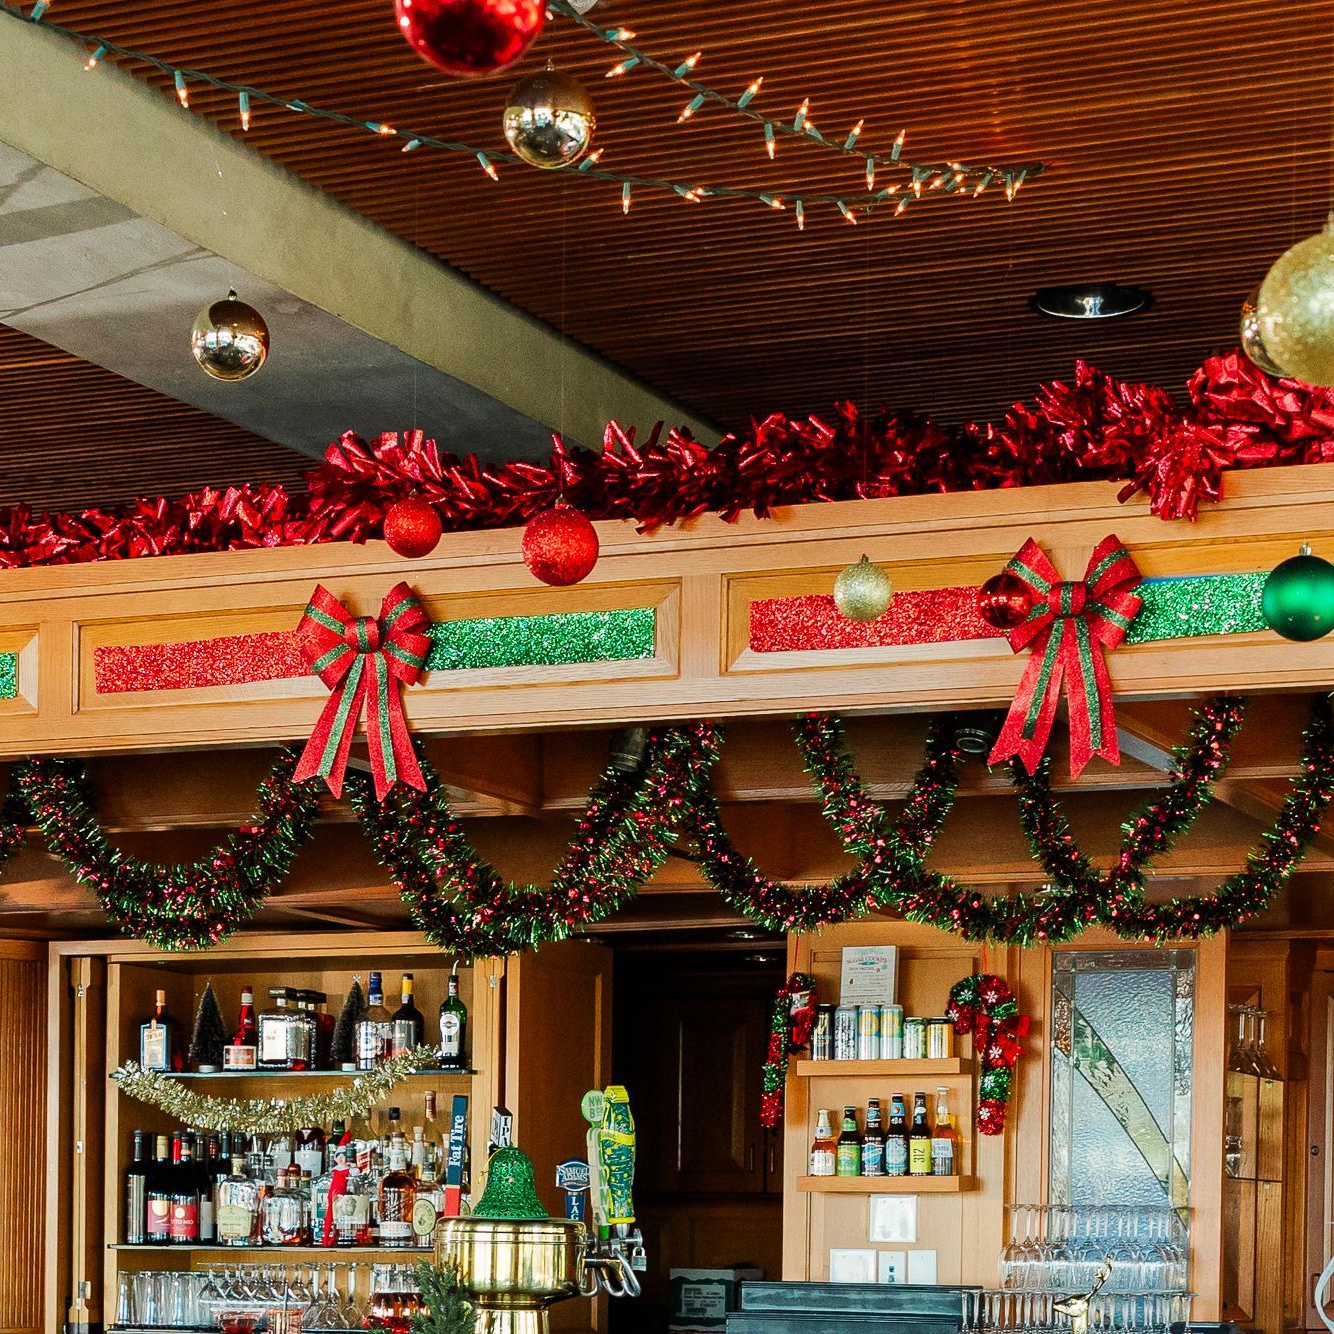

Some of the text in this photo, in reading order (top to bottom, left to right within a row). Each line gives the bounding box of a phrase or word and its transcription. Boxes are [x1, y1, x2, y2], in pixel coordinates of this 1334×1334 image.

[588, 1095, 603, 1107] NW
[501, 1117, 510, 1147] IPA
[448, 1114, 465, 1168] Fat Tire
[913, 1148, 926, 1163] 312
[558, 1166, 590, 1176] SAMUEL
[561, 1174, 589, 1182] ADAMS
[570, 1196, 579, 1221] LAG
